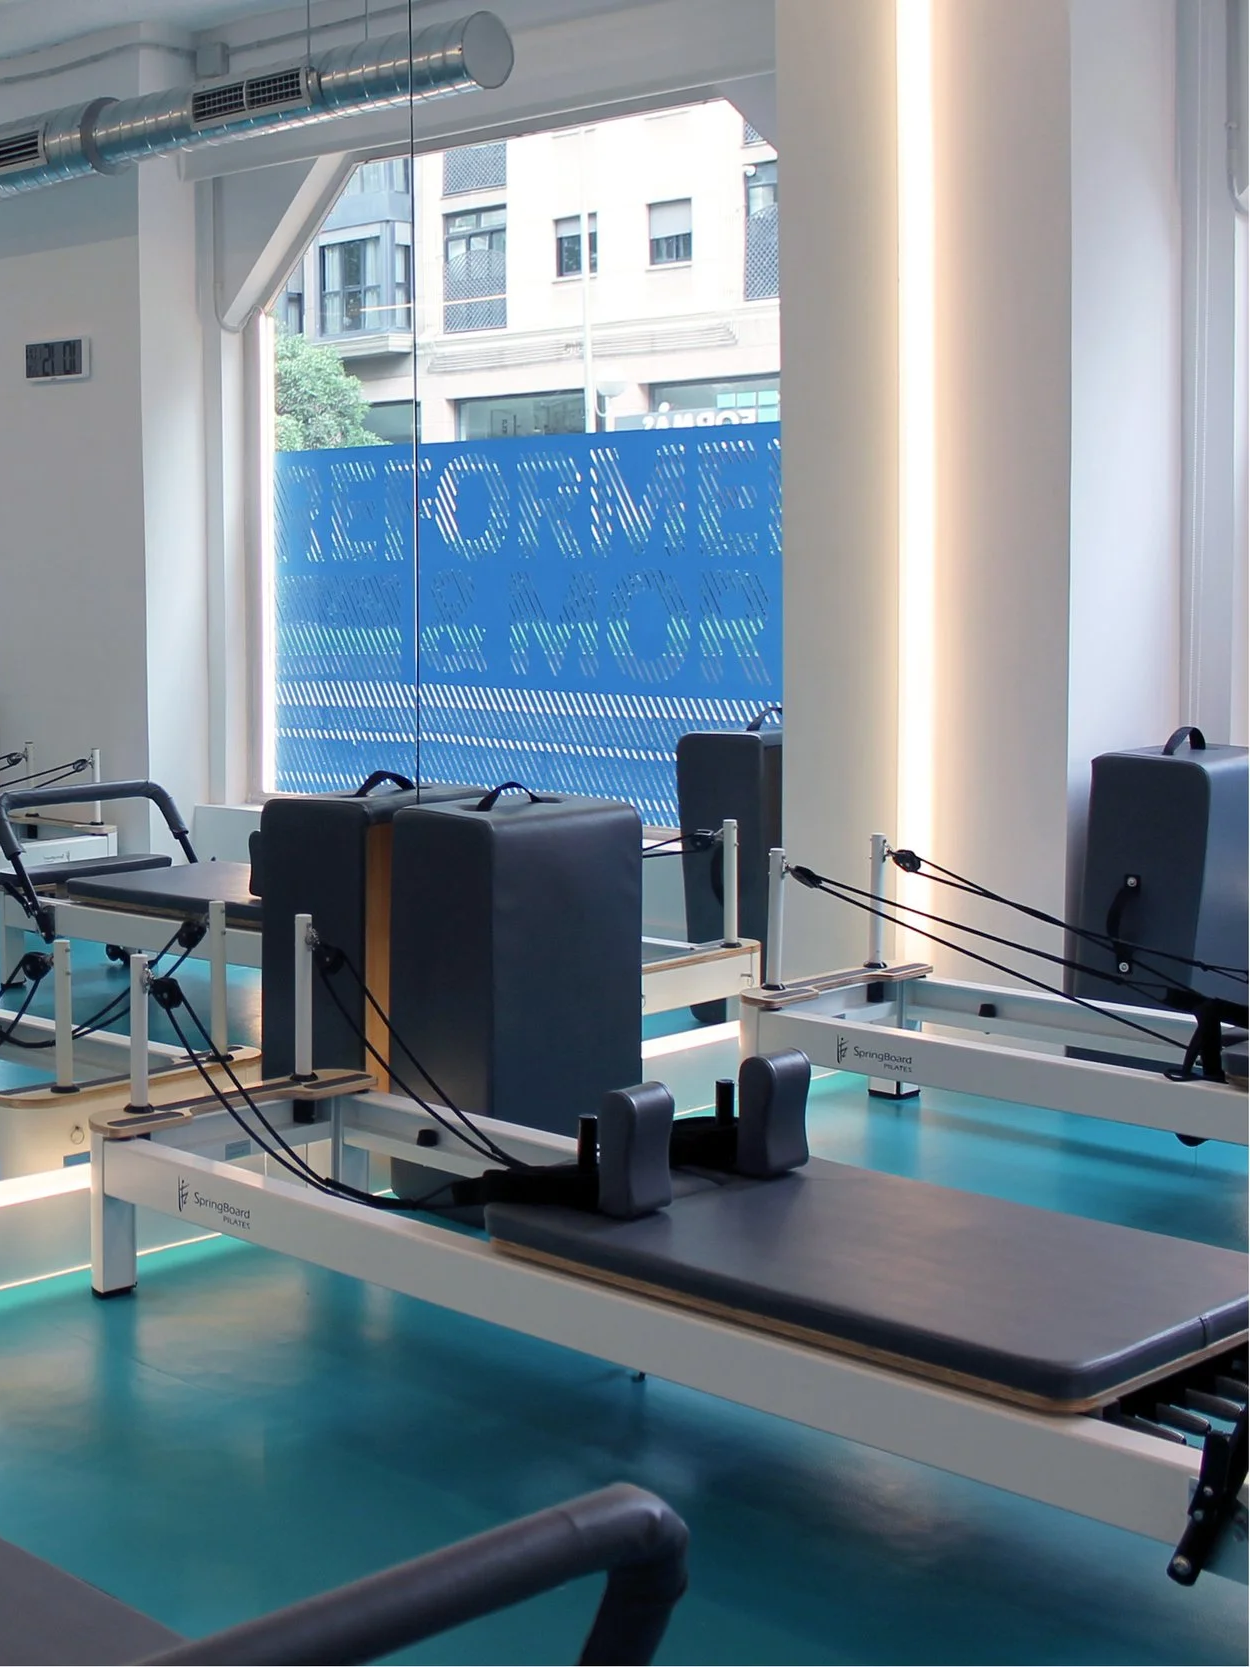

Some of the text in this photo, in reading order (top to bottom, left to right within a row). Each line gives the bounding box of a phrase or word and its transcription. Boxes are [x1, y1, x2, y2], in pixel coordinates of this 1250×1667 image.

[275, 438, 782, 562] REFORME
[853, 1045, 912, 1065] SpringBoard
[883, 1063, 912, 1073] PILATES
[194, 1191, 250, 1219] SpringBoard
[222, 1215, 250, 1230] PILATES
